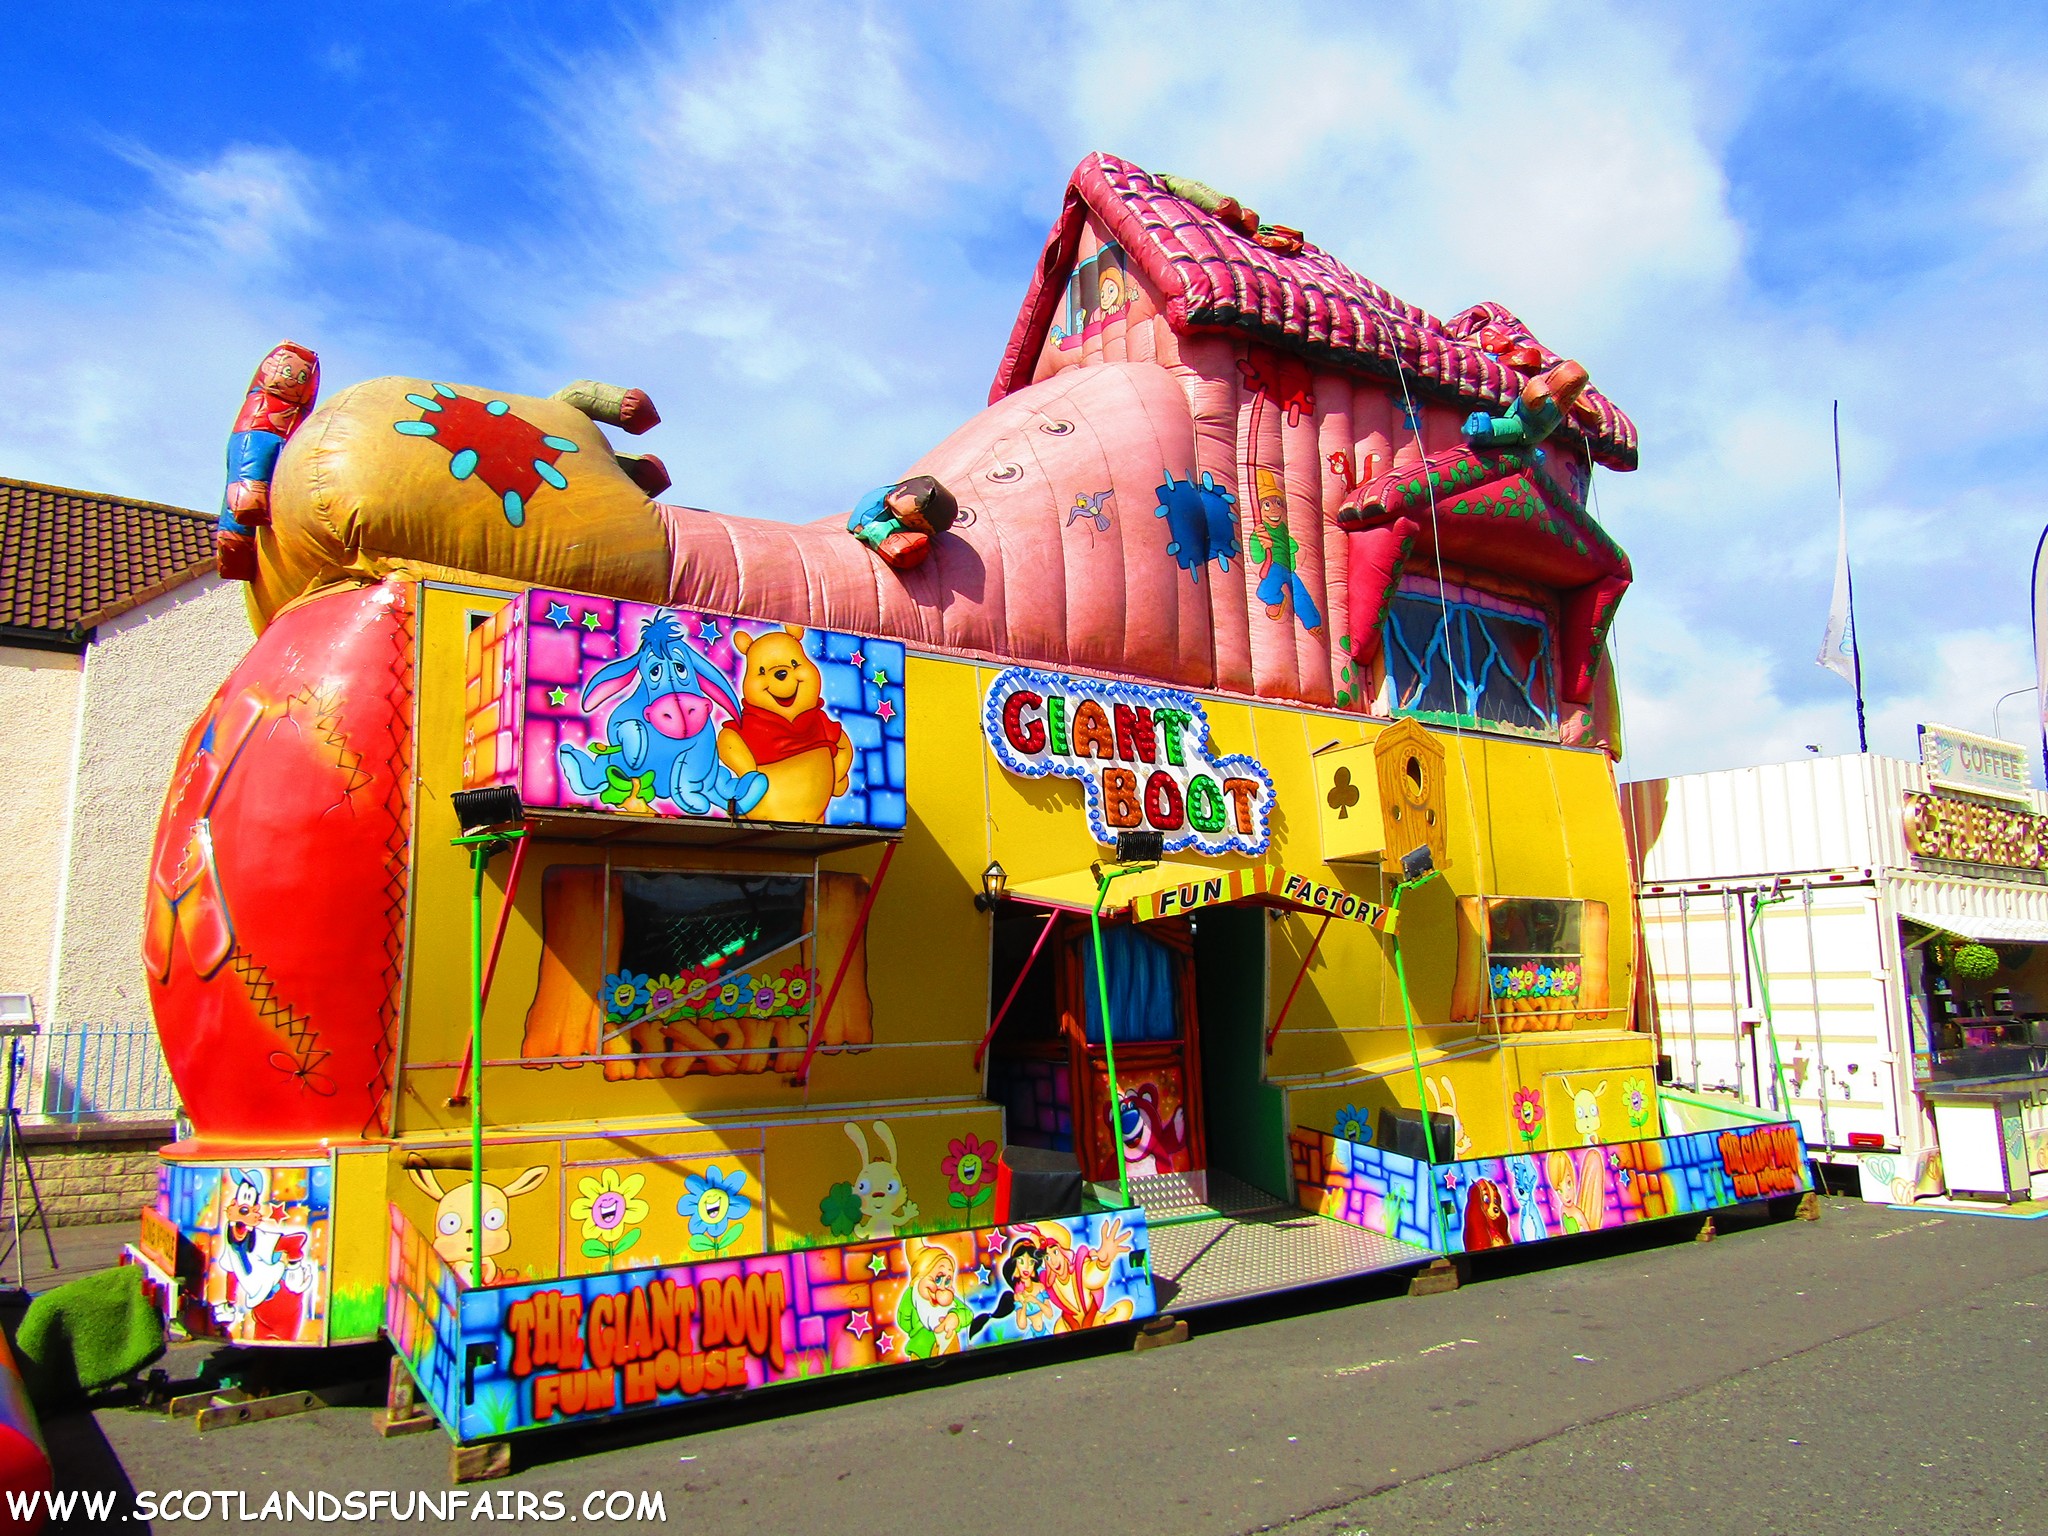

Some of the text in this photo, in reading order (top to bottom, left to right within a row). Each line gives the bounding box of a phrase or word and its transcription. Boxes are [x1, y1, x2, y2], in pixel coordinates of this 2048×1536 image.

[1003, 690, 1190, 766] GIANT
[1959, 742, 2020, 780] COFFEE
[1102, 768, 1259, 835] BOOT
[1159, 876, 1385, 927] FUN FACTORY
[509, 1269, 786, 1376] THE GIANT BOOT
[535, 1346, 749, 1419] FUN HOUSE
